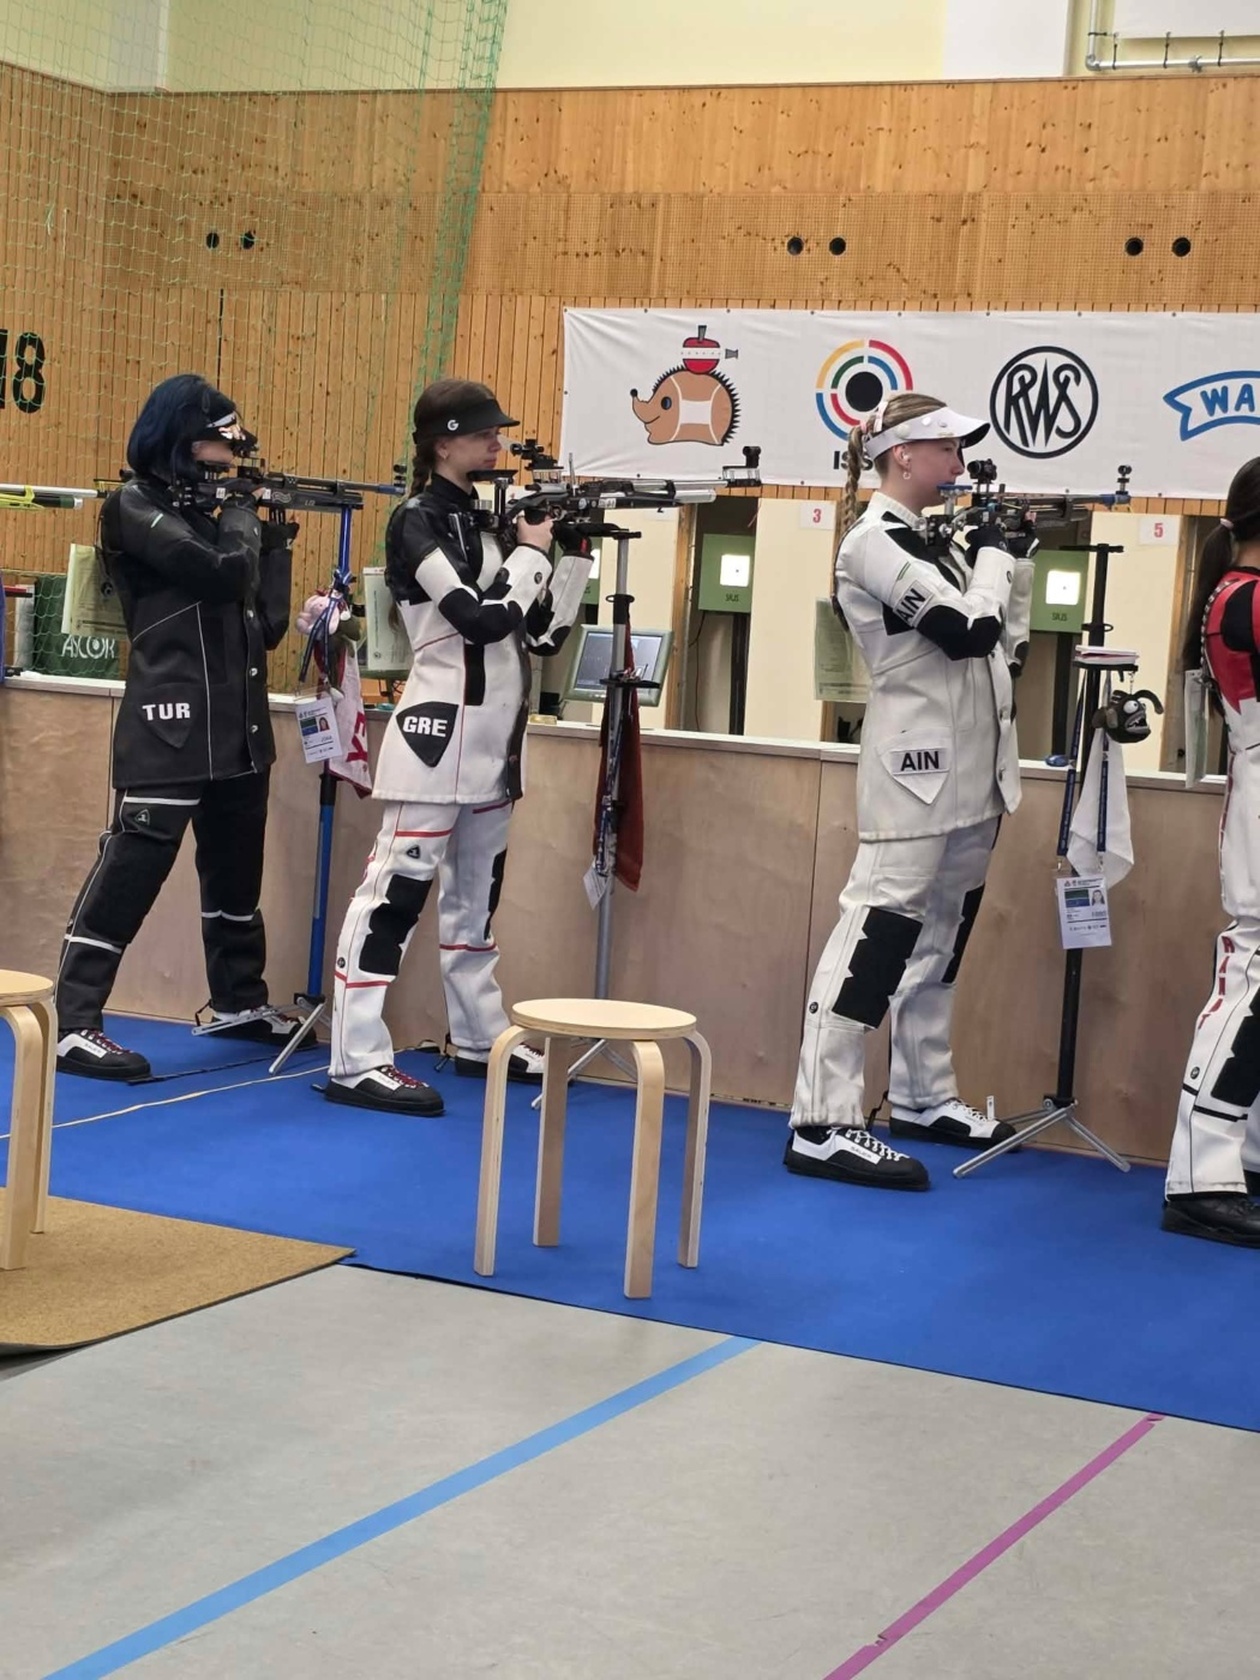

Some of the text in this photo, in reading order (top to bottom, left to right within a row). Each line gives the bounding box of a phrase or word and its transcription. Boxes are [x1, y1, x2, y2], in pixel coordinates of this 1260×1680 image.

[1003, 357, 1082, 448] RWS
[812, 508, 822, 524] 3
[1154, 522, 1164, 538] 5
[896, 587, 926, 621] AIN
[142, 702, 191, 721] TUR
[403, 715, 448, 738] GRE
[900, 750, 940, 771] AIN
